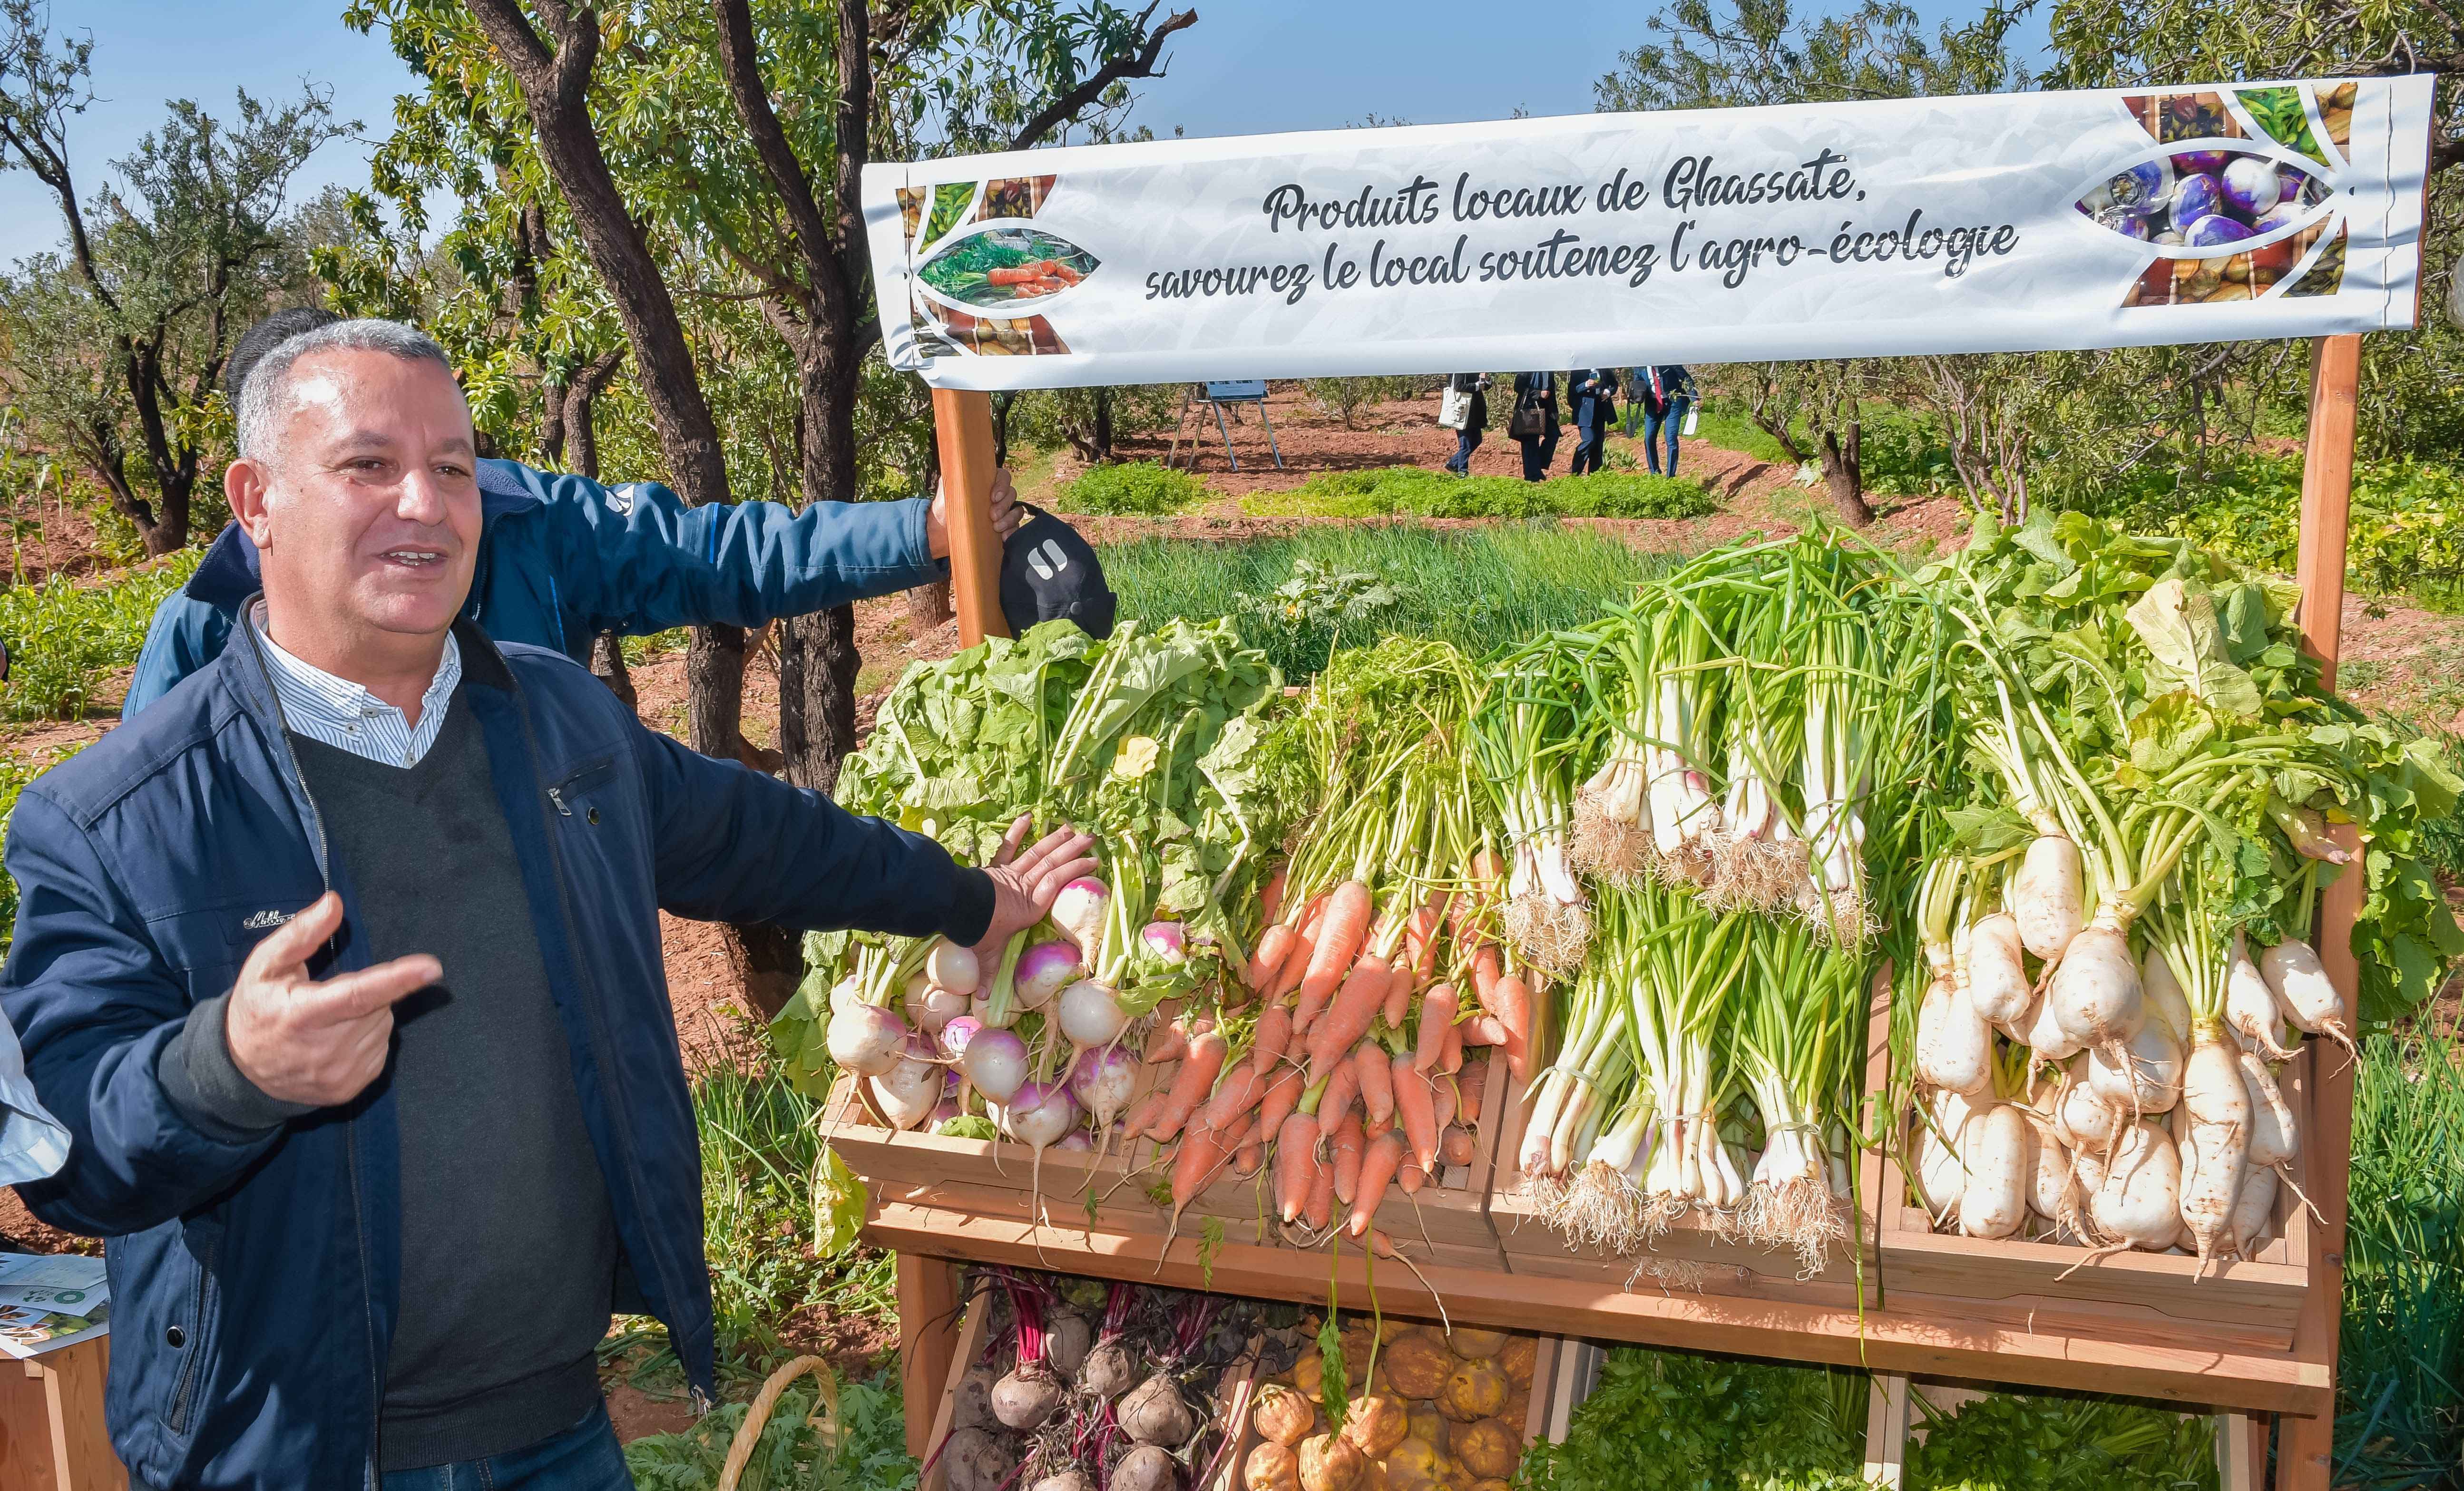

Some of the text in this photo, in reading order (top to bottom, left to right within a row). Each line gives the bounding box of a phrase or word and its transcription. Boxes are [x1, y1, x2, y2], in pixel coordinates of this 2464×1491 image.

[1262, 147, 1866, 233] Produits locaux de Ghassate,
[1145, 263, 1316, 305] savourez
[1323, 242, 1362, 290] le
[1370, 234, 1471, 288] local
[1479, 228, 1662, 289] soutenez
